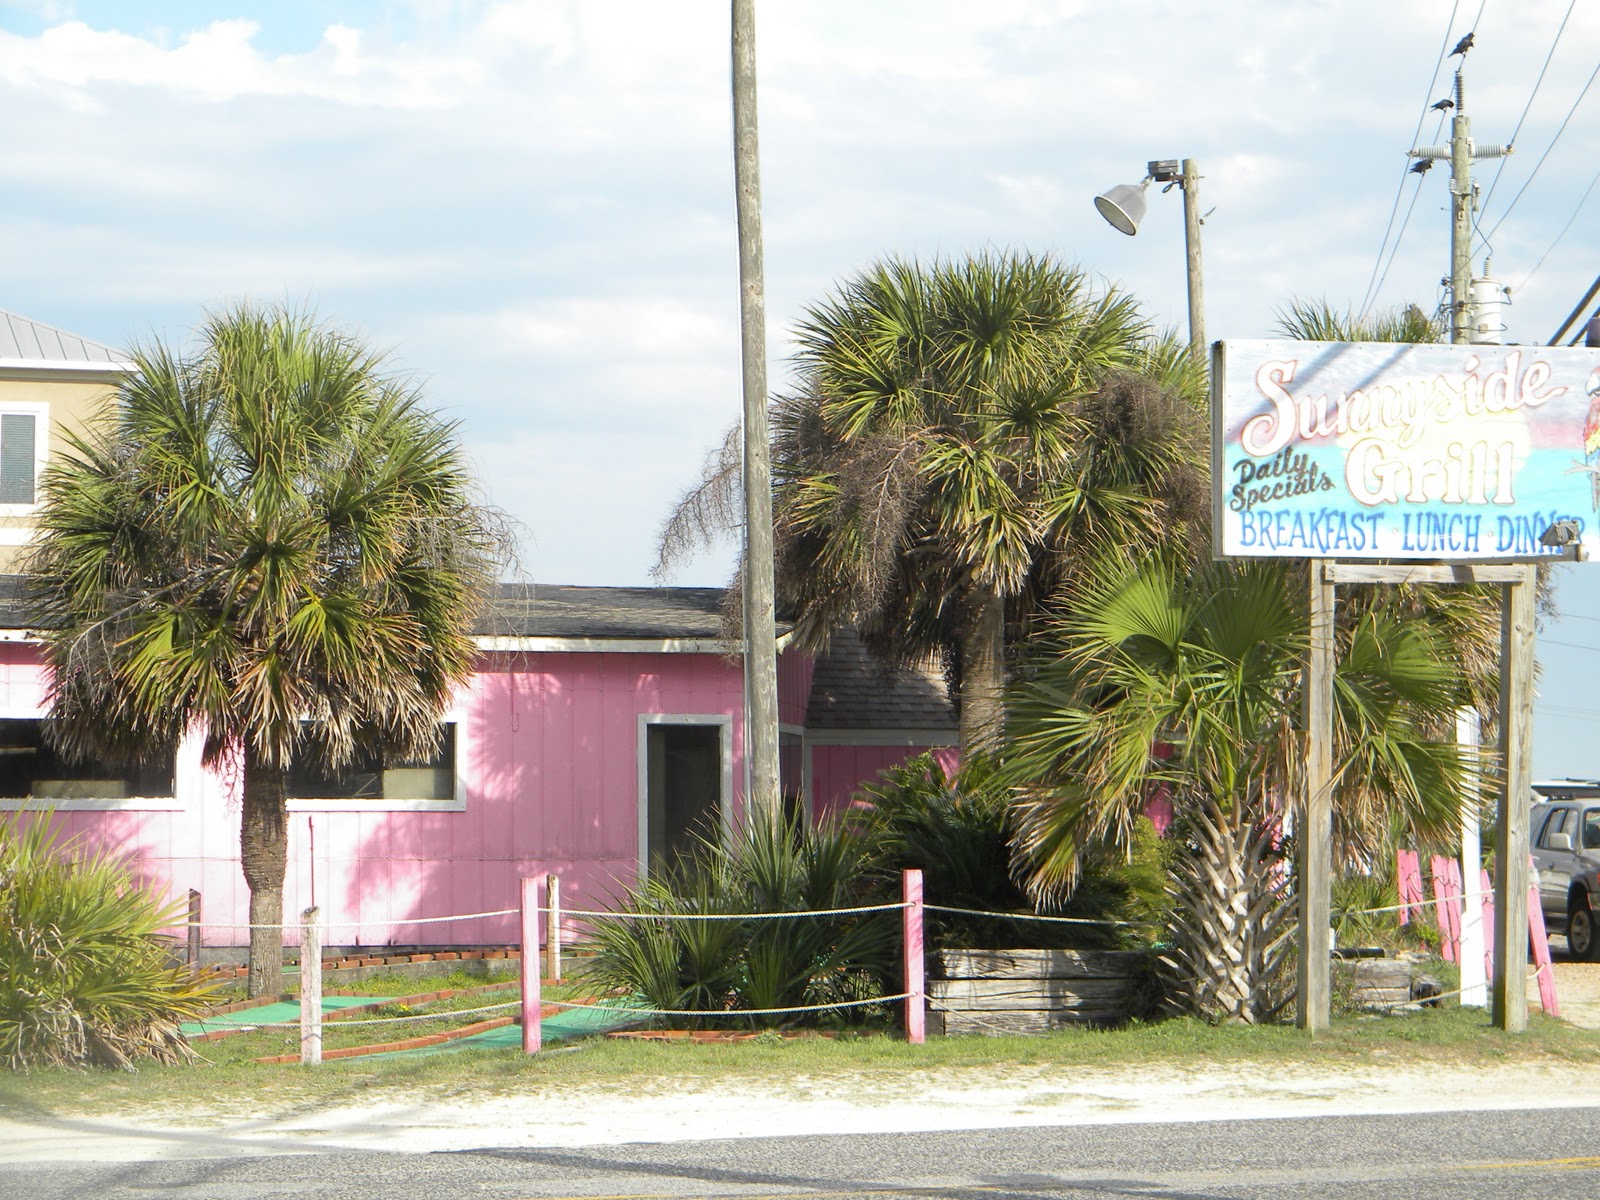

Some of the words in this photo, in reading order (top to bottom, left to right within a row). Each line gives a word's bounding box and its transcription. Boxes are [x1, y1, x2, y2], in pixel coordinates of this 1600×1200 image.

[1241, 351, 1567, 457] Sunnyside
[1230, 461, 1336, 512] Specials
[1233, 445, 1309, 484] Daily
[1345, 437, 1515, 506] Grill
[1239, 507, 1384, 554] BREAKFAST
[1402, 511, 1482, 552] LUNCH
